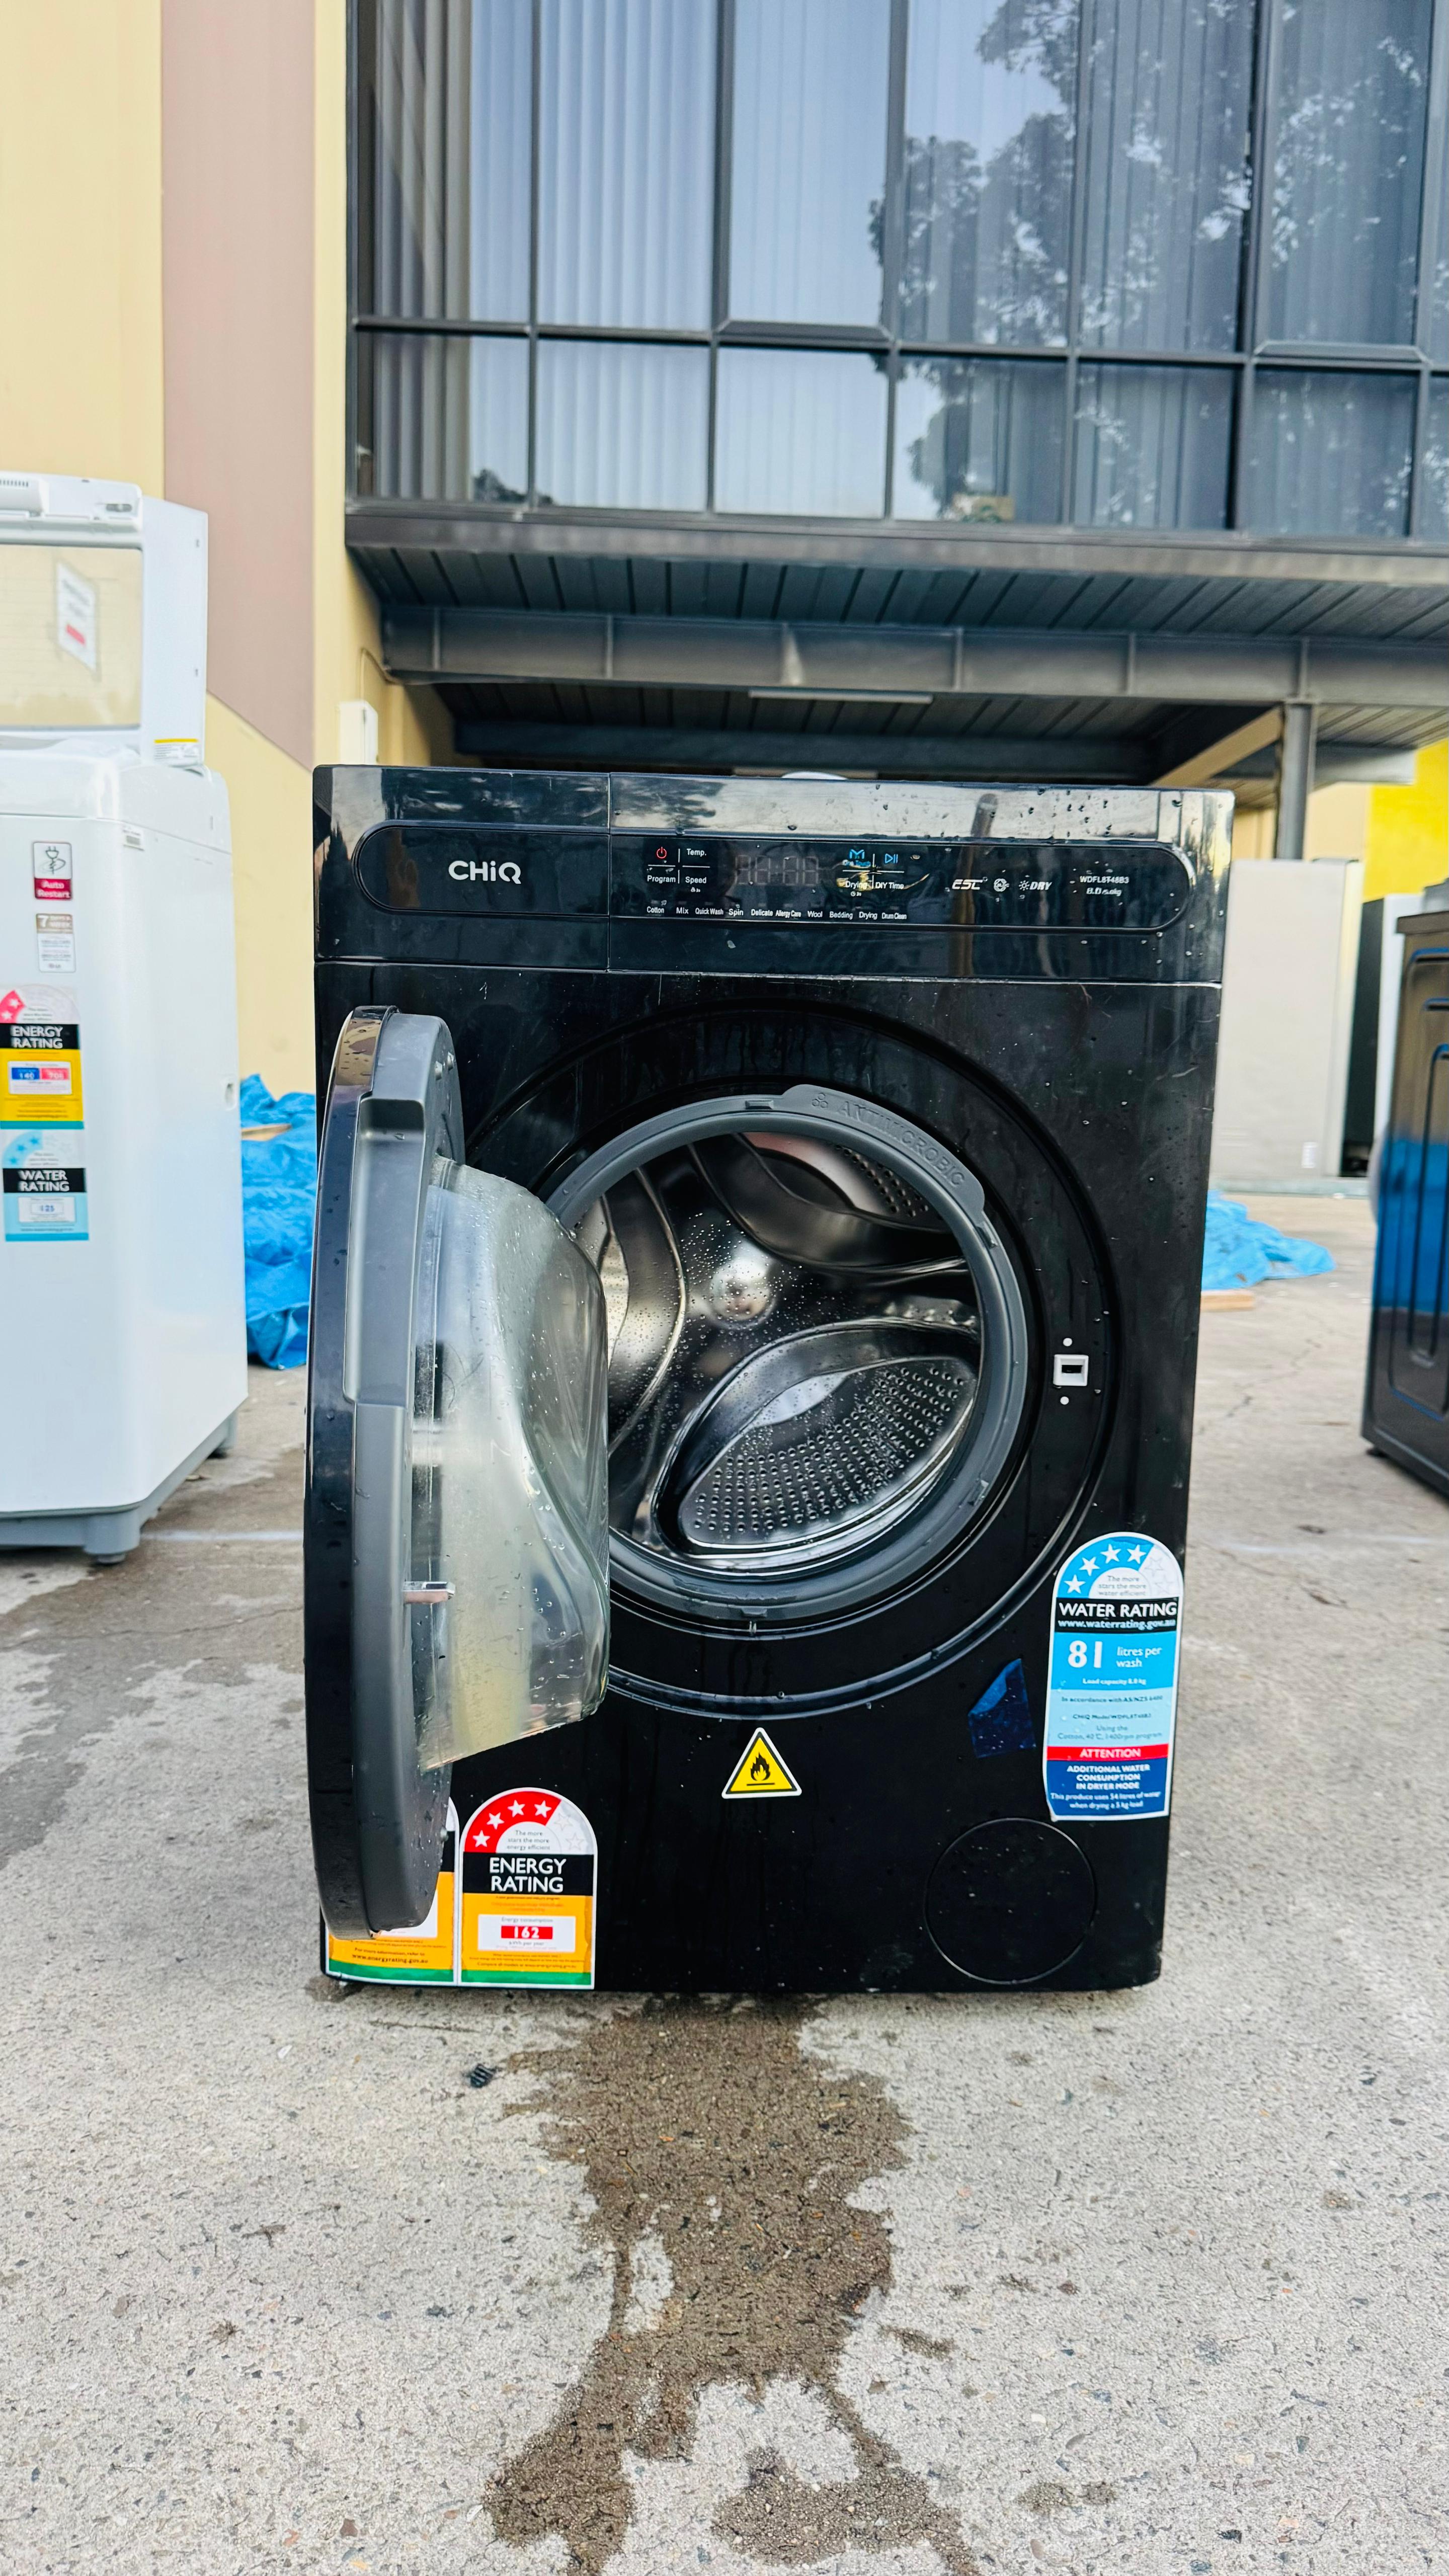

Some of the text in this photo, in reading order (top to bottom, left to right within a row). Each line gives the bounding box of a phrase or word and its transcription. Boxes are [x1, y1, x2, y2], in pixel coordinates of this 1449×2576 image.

[687, 848, 706, 856] Temp.
[448, 860, 521, 884] CHiQ
[647, 875, 676, 883] Program
[685, 876, 707, 884] Speed
[42, 880, 64, 889] Auto
[846, 880, 867, 889] Drying
[1030, 881, 1052, 891] DRY
[37, 890, 70, 898] Restart
[729, 909, 744, 917] Spin
[775, 910, 790, 918] Allergy
[830, 911, 853, 920] Bedding
[859, 912, 877, 920] Drying
[38, 915, 49, 928] 7
[10, 1025, 63, 1037] ENERGY
[11, 1037, 63, 1049] RATING
[18, 1170, 67, 1181] WATER
[18, 1181, 70, 1192] RATING
[1059, 1602, 1177, 1618] WATER RATING
[1058, 1619, 1175, 1630] www.waterrating.gov.au
[1068, 1640, 1103, 1668] 81
[1117, 1646, 1162, 1658] litres per
[1116, 1658, 1142, 1668] wash
[1079, 1748, 1141, 1758] ATTENTION
[1121, 1764, 1151, 1772] WATER
[490, 1857, 567, 1875] ENERGY
[491, 1876, 564, 1893] RATING
[514, 1926, 540, 1939] 162
